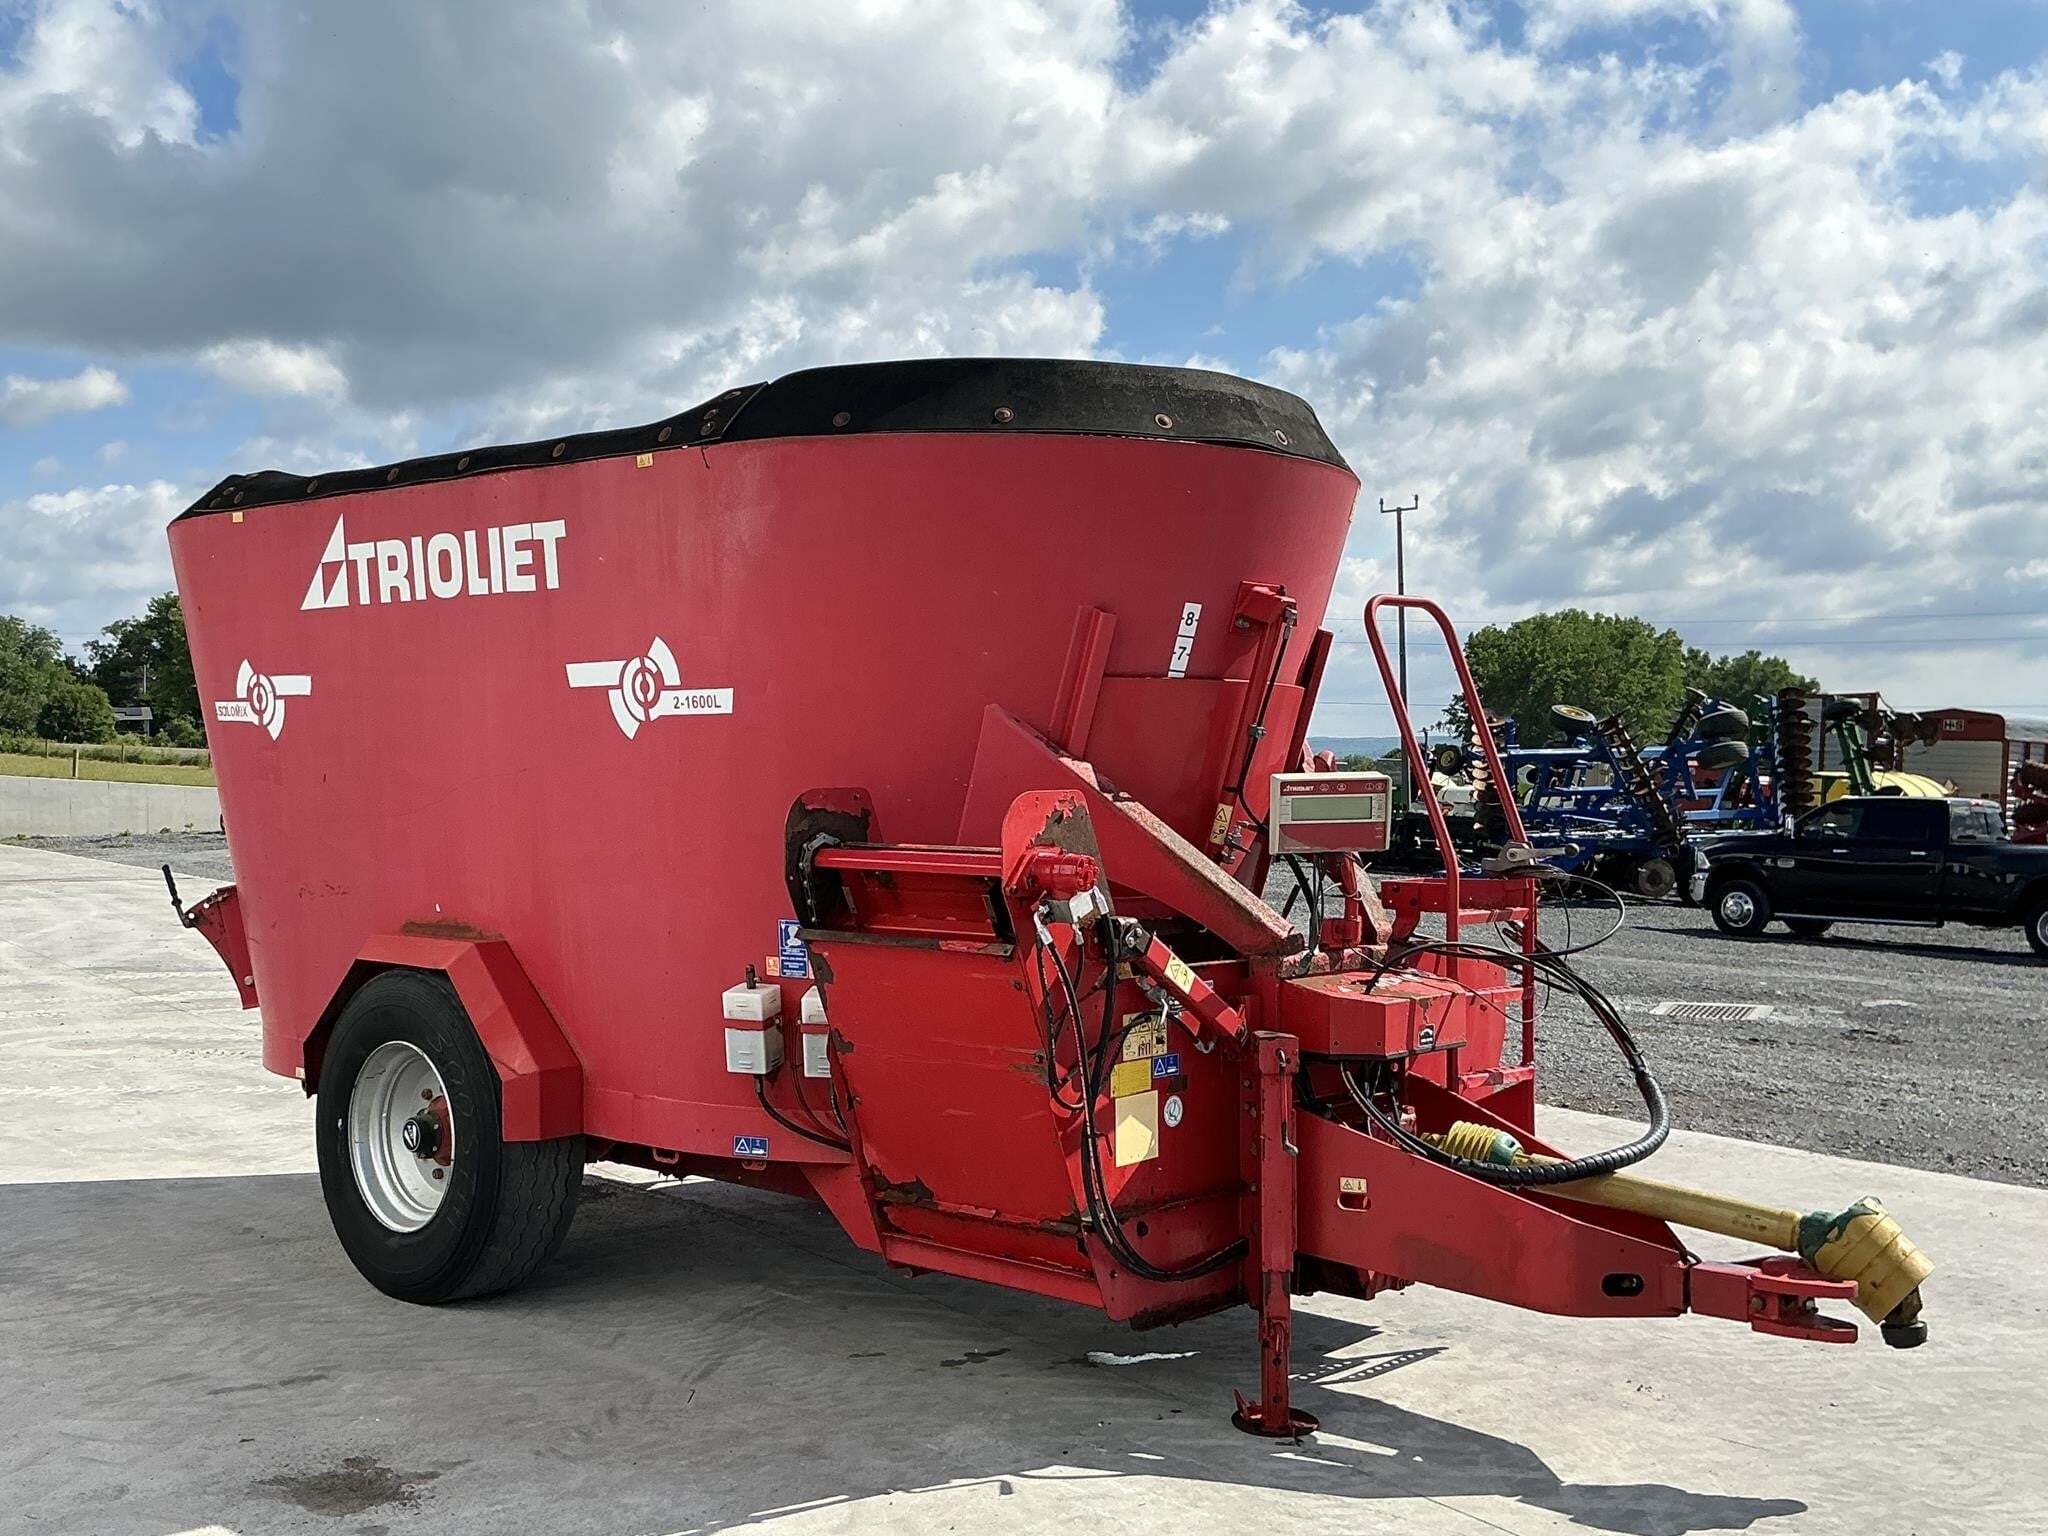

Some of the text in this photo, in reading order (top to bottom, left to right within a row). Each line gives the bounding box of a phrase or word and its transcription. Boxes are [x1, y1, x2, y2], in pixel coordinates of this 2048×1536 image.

[347, 519, 566, 605] TRIOLIET
[1185, 611, 1195, 626] 8
[1177, 646, 1187, 660] 7
[673, 694, 721, 709] 2-1600L
